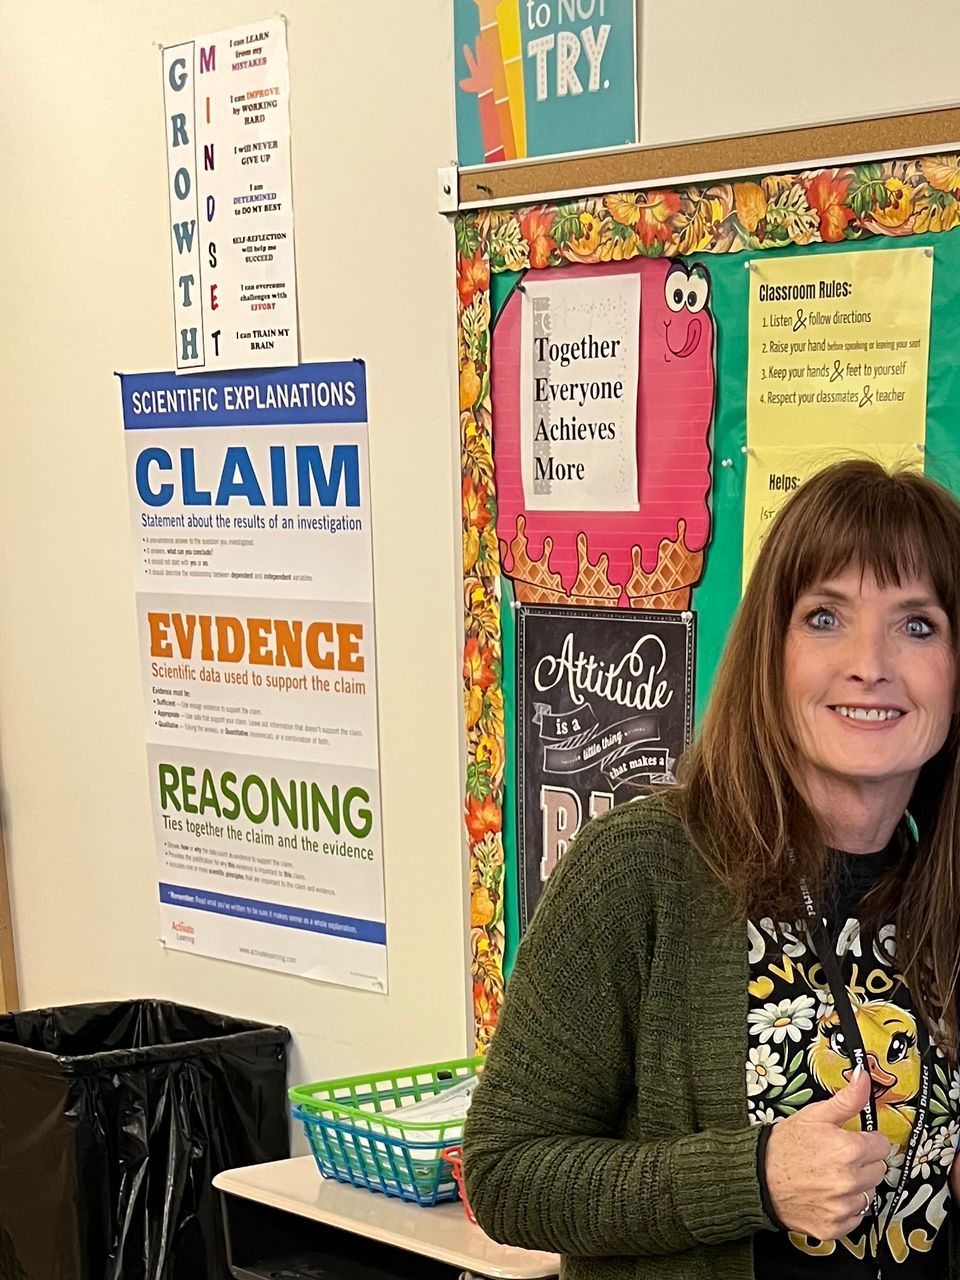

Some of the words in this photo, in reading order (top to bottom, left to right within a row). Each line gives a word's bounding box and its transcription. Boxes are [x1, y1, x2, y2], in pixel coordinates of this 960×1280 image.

[234, 38, 245, 47] can
[246, 31, 270, 44] LEARN
[235, 48, 252, 59] from
[252, 46, 262, 55] my
[232, 56, 268, 72] MISTAKES
[527, 24, 611, 102] TRY.
[234, 95, 246, 103] can
[246, 86, 280, 101] IMPROVE
[232, 107, 240, 115] by
[242, 100, 278, 113] WORKING
[244, 114, 266, 126] HARD
[238, 144, 252, 153] will
[252, 140, 278, 151] NEVER
[241, 156, 259, 165] GIVE
[260, 154, 271, 163] UP
[233, 192, 277, 204] DETERMINED
[234, 208, 241, 216] to
[242, 206, 252, 214] DO
[252, 205, 262, 213] MY
[264, 203, 282, 212] BEST
[232, 232, 287, 244] SELF-REFLECTION
[254, 244, 266, 253] help
[245, 254, 274, 263] SUCCEED
[256, 282, 286, 290] overcome
[759, 282, 816, 302] Classroom
[819, 280, 853, 299] Rules:
[240, 294, 270, 302] challenges
[272, 292, 288, 300] with
[250, 302, 276, 311] EFFORT
[762, 316, 769, 328] 1.
[770, 314, 793, 328] Listen
[792, 308, 808, 332] &
[808, 312, 832, 326] follow
[832, 310, 872, 325] directions
[252, 329, 276, 338] TRAIN
[277, 328, 290, 336] MY
[250, 341, 274, 350] BRAIN
[534, 334, 621, 367] Together
[762, 343, 768, 354] 2.
[769, 340, 788, 354] Raise
[790, 342, 807, 356] your
[808, 338, 826, 352] hand
[827, 342, 844, 352] before
[844, 341, 868, 352] speaking
[868, 342, 875, 350] or
[875, 339, 895, 352] leaving
[896, 341, 908, 351] your
[761, 370, 768, 381] 3.
[768, 366, 787, 381] Keep
[788, 367, 805, 382] your
[806, 363, 830, 378] hands
[829, 359, 844, 383] &
[846, 362, 862, 377] feet
[863, 364, 873, 377] to
[873, 360, 908, 380] yourself
[131, 386, 219, 414] SCIENTIFIC
[223, 380, 357, 411] EXPLANATIONS
[534, 377, 624, 407] Everyone
[760, 394, 766, 404] 4.
[767, 391, 797, 407] Respect
[798, 393, 816, 407] your
[816, 390, 859, 404] classmates
[858, 384, 874, 408] &
[875, 388, 906, 403] teacher
[534, 416, 616, 442] Achieves
[135, 444, 362, 508] CLAIM
[534, 456, 585, 482] More
[768, 474, 800, 493] Helps:
[141, 512, 185, 528] Statement
[188, 514, 213, 528] about
[216, 514, 231, 528] the
[234, 514, 266, 530] results
[268, 514, 278, 530] of
[282, 517, 294, 530] an
[297, 514, 362, 534] investigation
[147, 612, 366, 673] EVIDENCE
[151, 662, 196, 682] Scientific
[200, 666, 221, 684] data
[224, 668, 248, 686] used
[252, 670, 262, 686] to
[265, 672, 308, 693] support
[311, 676, 330, 692] the
[334, 677, 366, 696] claim
[534, 632, 674, 711] Attitude
[556, 718, 568, 735] is
[572, 718, 581, 732] a
[582, 742, 602, 761] little
[601, 730, 624, 750] thing
[609, 762, 628, 780] that
[628, 756, 658, 770] makes
[658, 757, 665, 766] a
[158, 763, 373, 840] REASONING
[162, 814, 184, 832] Ties
[186, 820, 224, 839] together
[226, 824, 243, 842] the
[246, 828, 274, 846] claim
[278, 832, 298, 850] and
[301, 836, 320, 854] the
[322, 841, 374, 862] evidence
[910, 1109, 926, 1148] School
[920, 1065, 930, 1108] District
